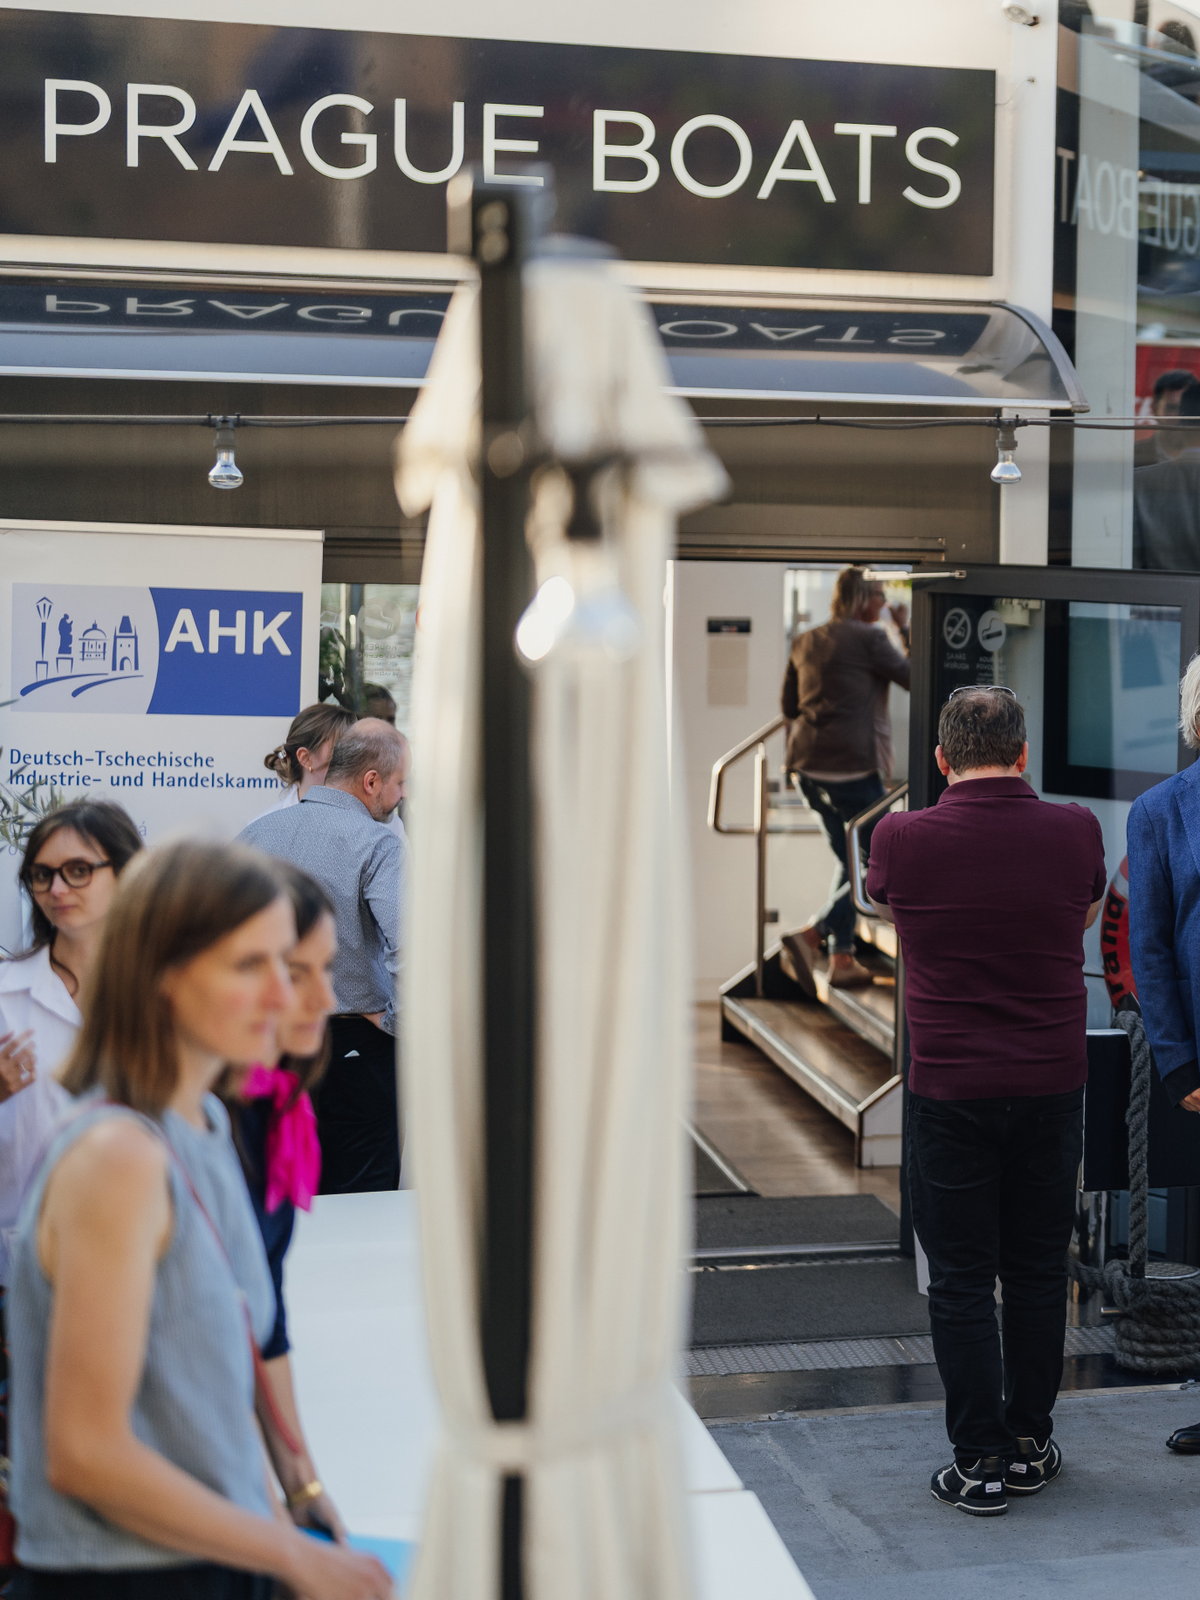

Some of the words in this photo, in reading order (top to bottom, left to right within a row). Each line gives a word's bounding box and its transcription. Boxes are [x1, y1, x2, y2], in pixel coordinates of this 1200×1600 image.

[45, 78, 544, 187] PRAGUE
[593, 108, 962, 209] BOATS
[164, 608, 292, 656] AHK
[9, 748, 215, 768] Deutsch-Tschechische
[9, 769, 102, 788] Industrie-
[110, 771, 144, 787] und
[152, 772, 287, 789] Handelskamm
[1102, 889, 1124, 995] rand
